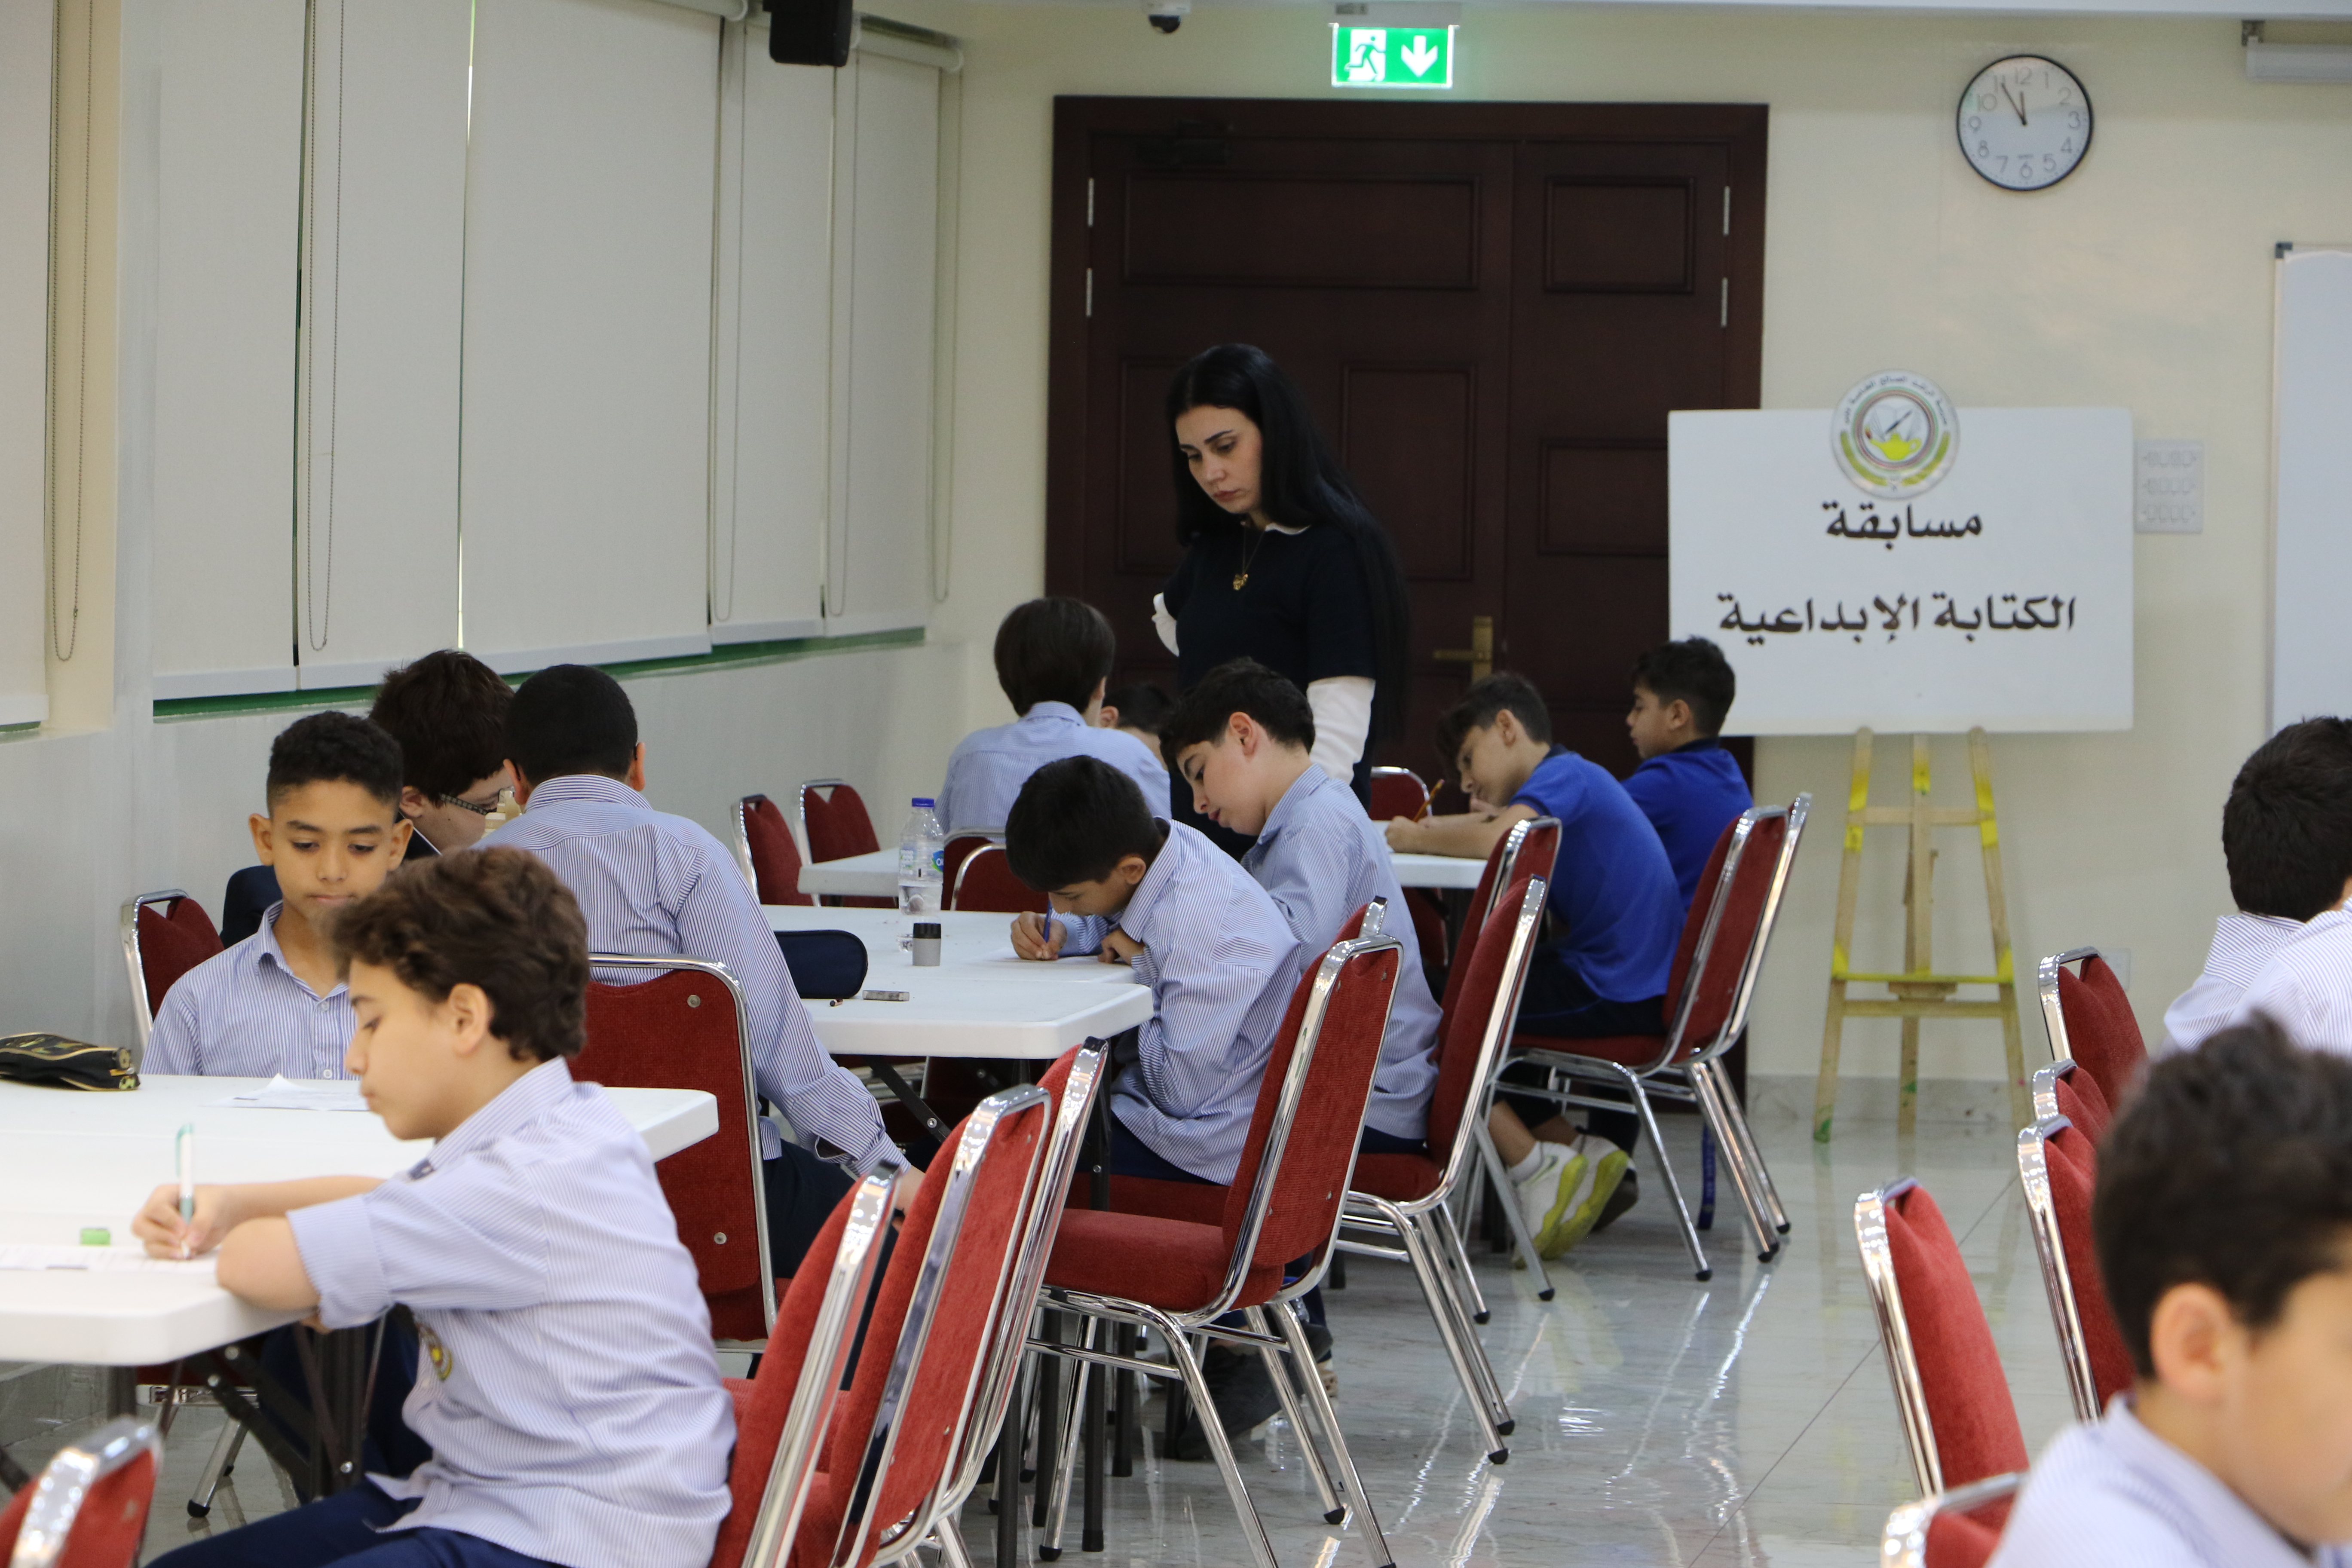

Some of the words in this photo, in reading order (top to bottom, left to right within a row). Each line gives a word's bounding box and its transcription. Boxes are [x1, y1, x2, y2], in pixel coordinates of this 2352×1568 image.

[1993, 74, 2006, 93] 11
[2015, 66, 2032, 85] 12
[2044, 70, 2049, 89] 1
[1978, 93, 1997, 111] 10
[2057, 87, 2071, 105] 2
[1968, 115, 1982, 133] 9
[2067, 111, 2080, 129] 3
[1978, 140, 1989, 157] 8
[2061, 136, 2072, 153] 4
[1996, 155, 2009, 173] 7
[2020, 161, 2033, 178] 6
[2043, 153, 2056, 172] 5
[1822, 501, 1982, 550] مسابقة
[1718, 593, 1919, 645] الإبداعية
[1932, 592, 2076, 642] الكتابة
